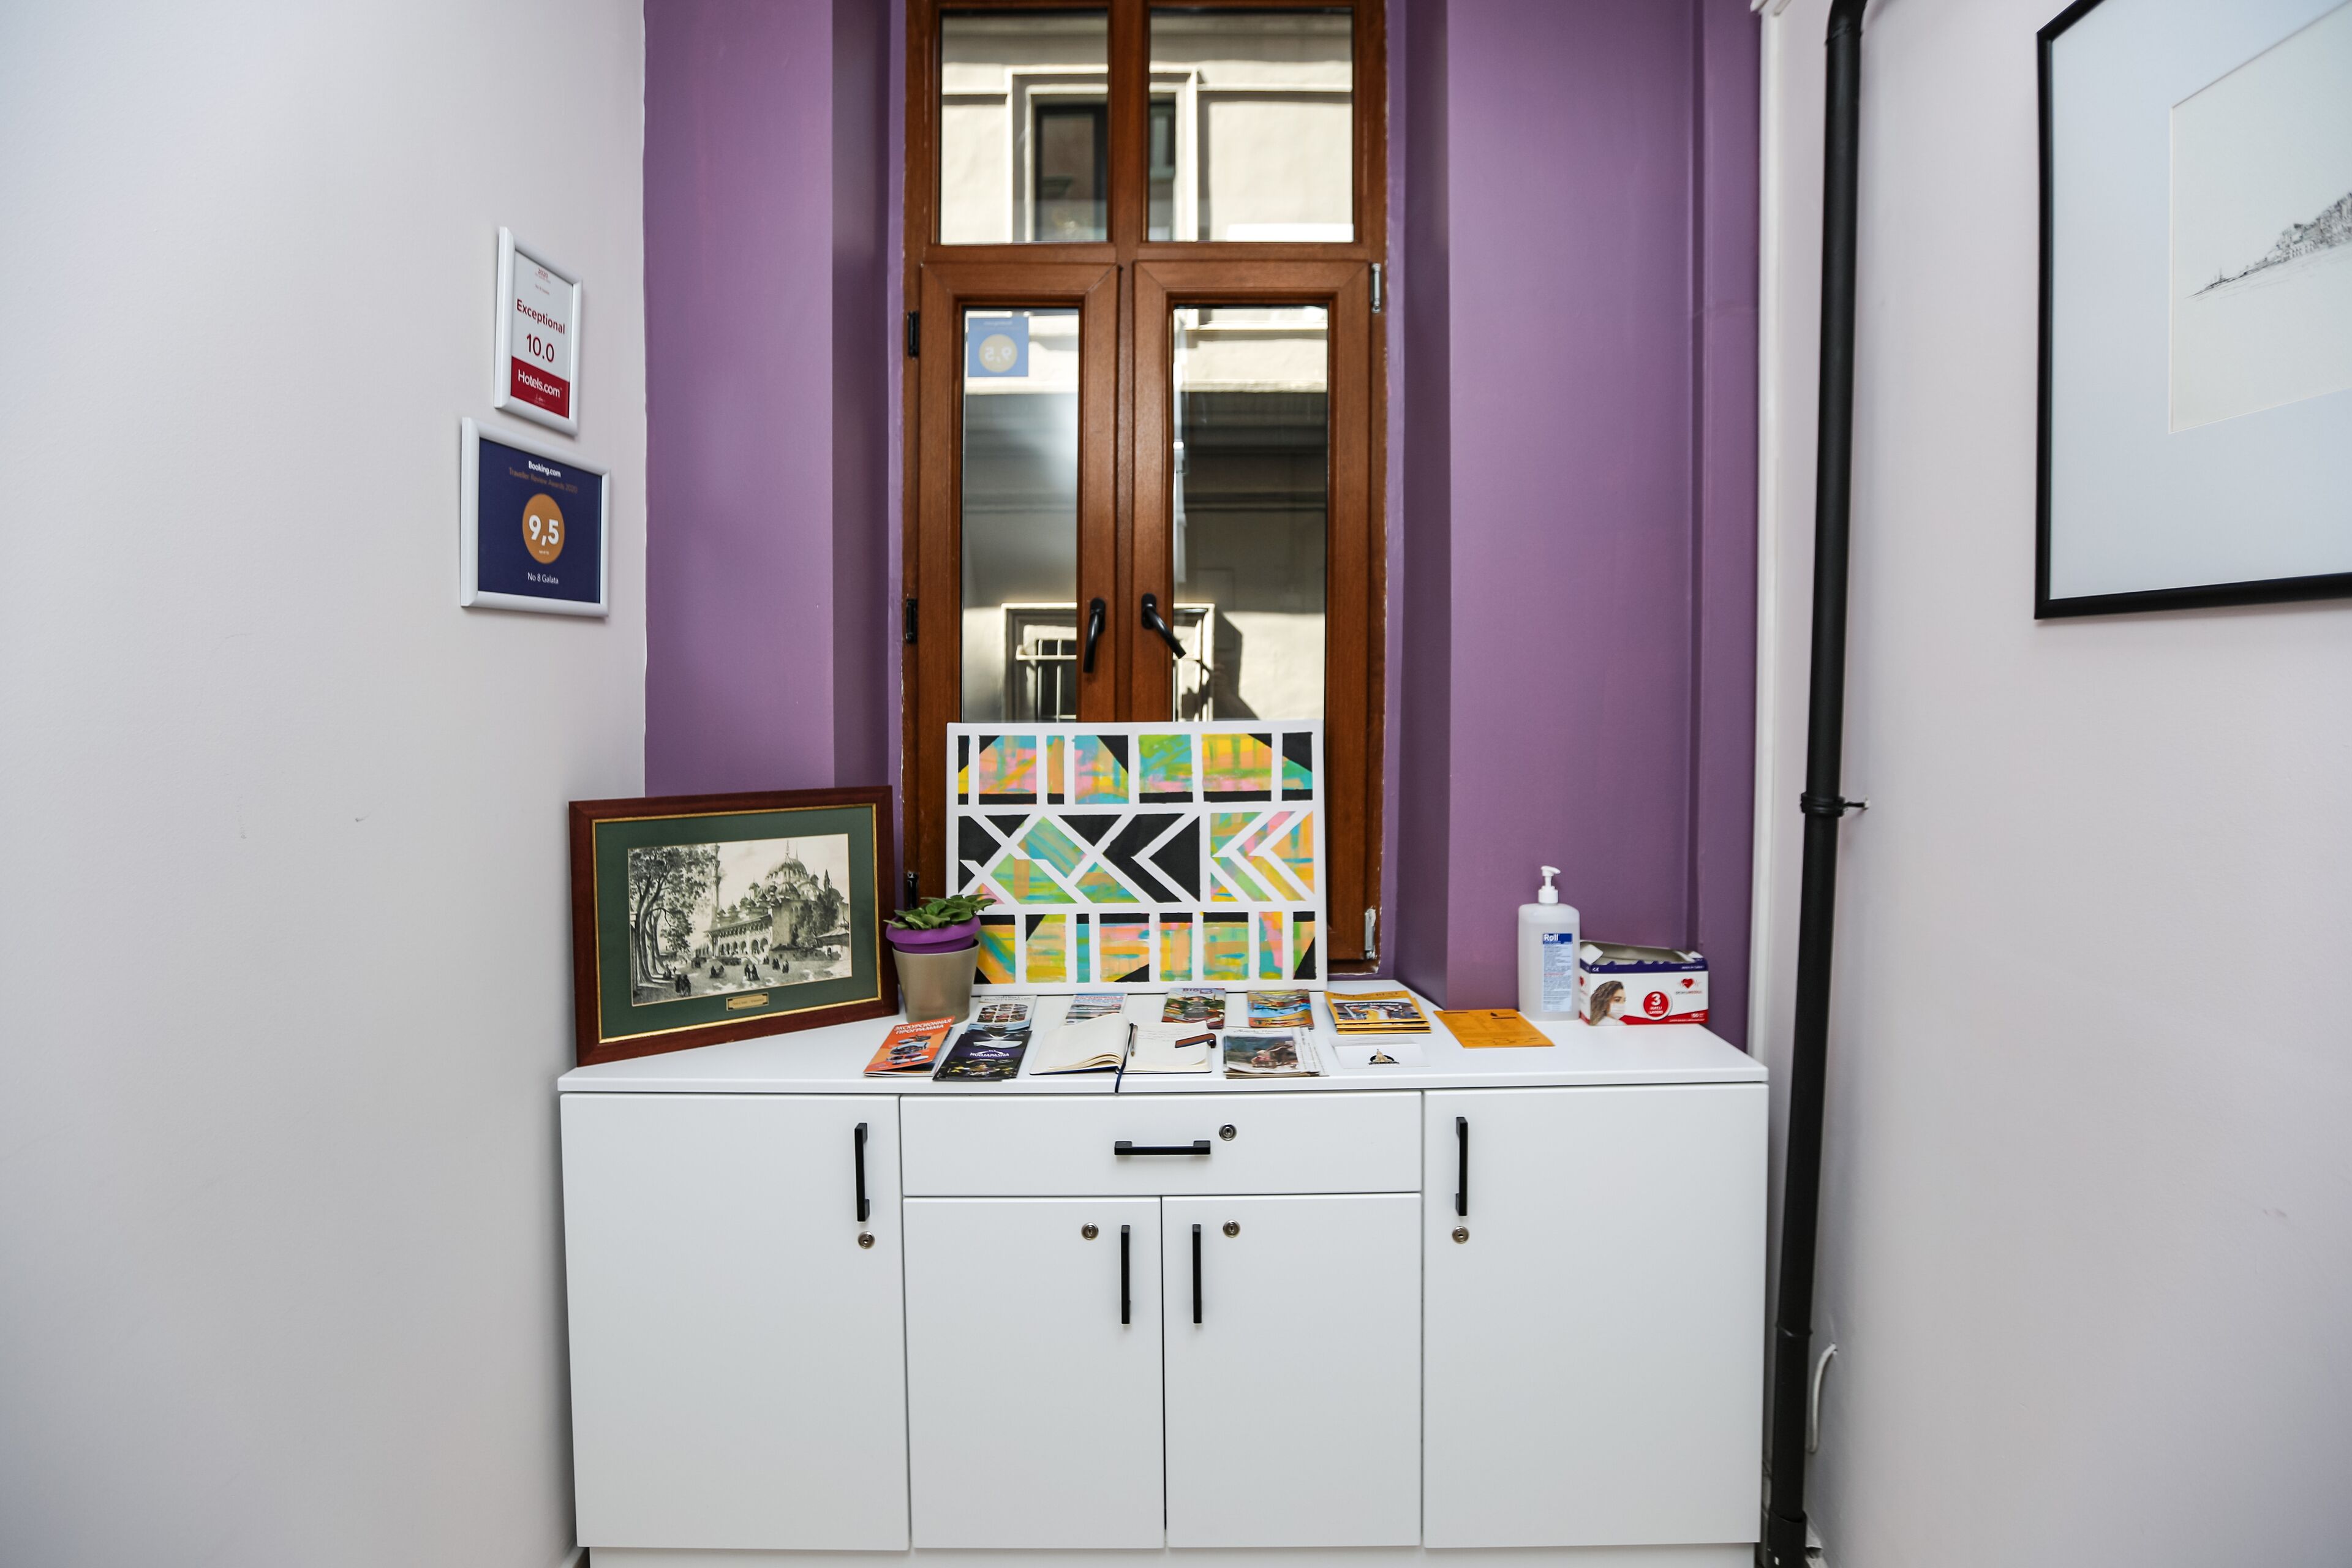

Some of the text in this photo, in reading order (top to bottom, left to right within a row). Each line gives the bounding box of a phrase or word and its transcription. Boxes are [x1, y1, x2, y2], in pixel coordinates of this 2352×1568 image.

[516, 298, 565, 334] Exceptional
[527, 333, 554, 363] 10.0
[518, 369, 560, 398] Hotels.com
[529, 461, 561, 477] Booking.com
[529, 514, 559, 546] 9,5
[528, 572, 559, 584] No 8 Galata
[1651, 993, 1661, 1006] 3
